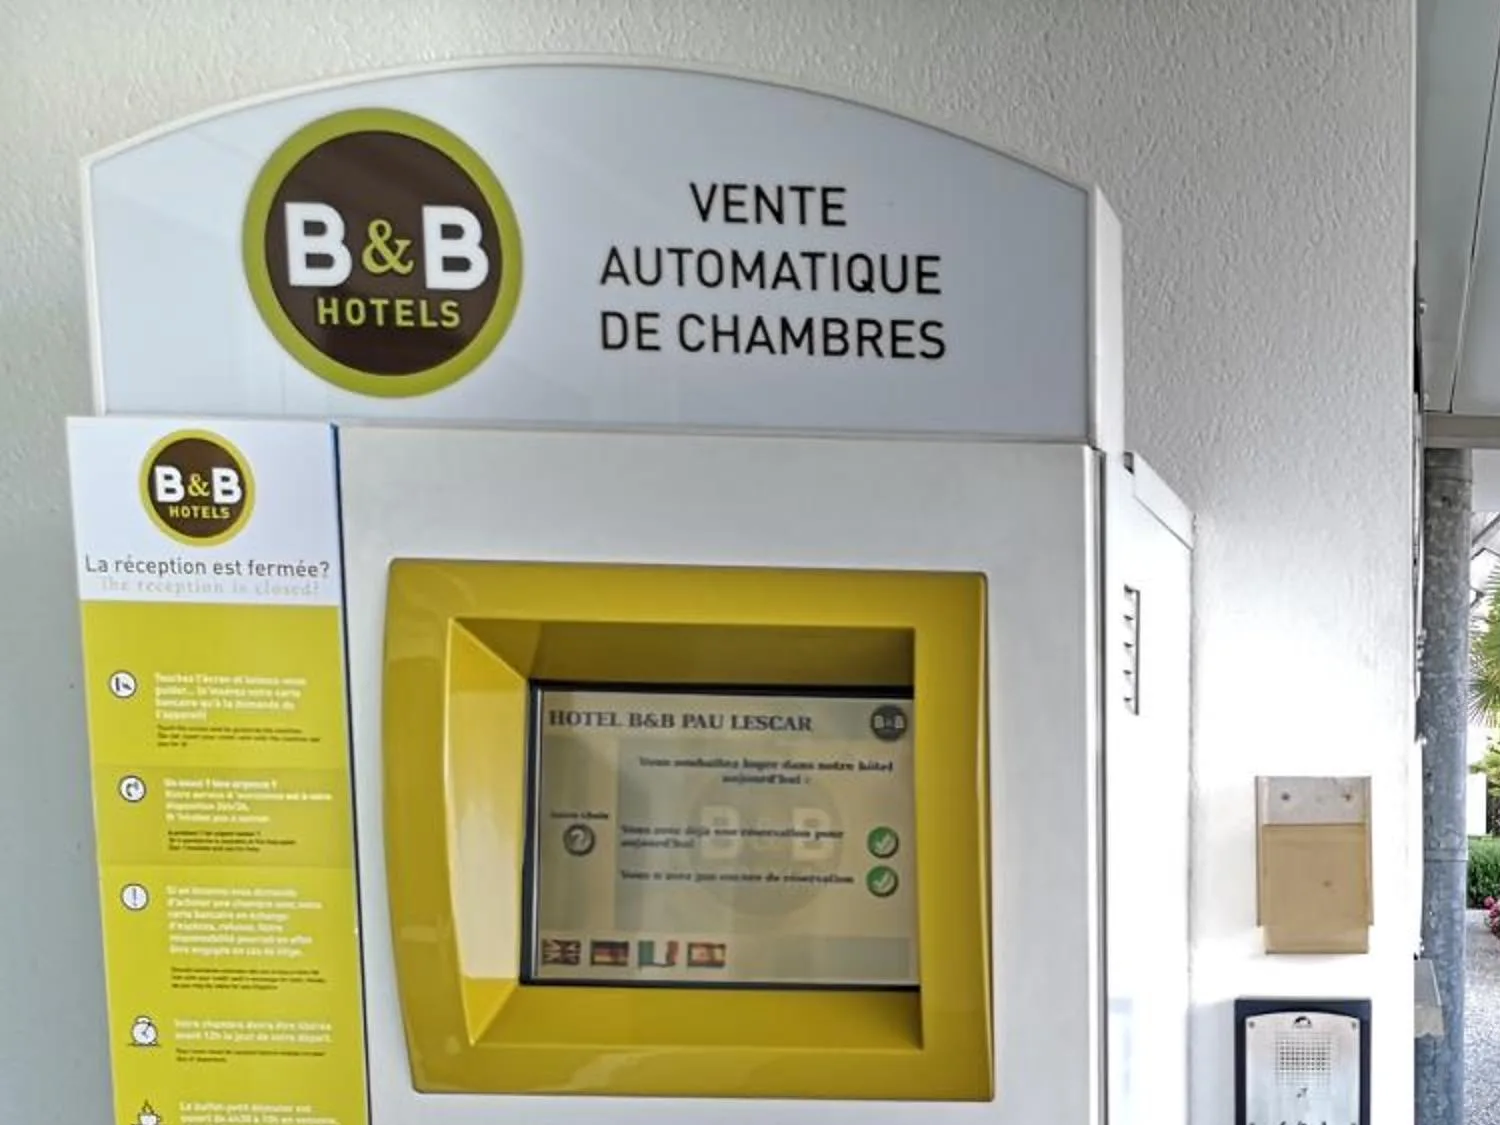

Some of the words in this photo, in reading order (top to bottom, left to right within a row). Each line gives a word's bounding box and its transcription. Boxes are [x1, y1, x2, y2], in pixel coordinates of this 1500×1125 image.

[688, 181, 847, 228] VENTE
[600, 246, 942, 296] AUTOMATIQUE
[317, 297, 461, 328] HOTELS
[601, 311, 660, 353] DE
[676, 314, 946, 360] CHAMBRES
[169, 505, 231, 519] HOTELS
[85, 553, 109, 573] La
[114, 553, 207, 578] réception
[213, 559, 242, 577] est
[549, 710, 622, 727] HOTEL
[628, 712, 676, 729] B&B
[681, 713, 724, 730] PAU
[730, 714, 813, 731] LESCAR
